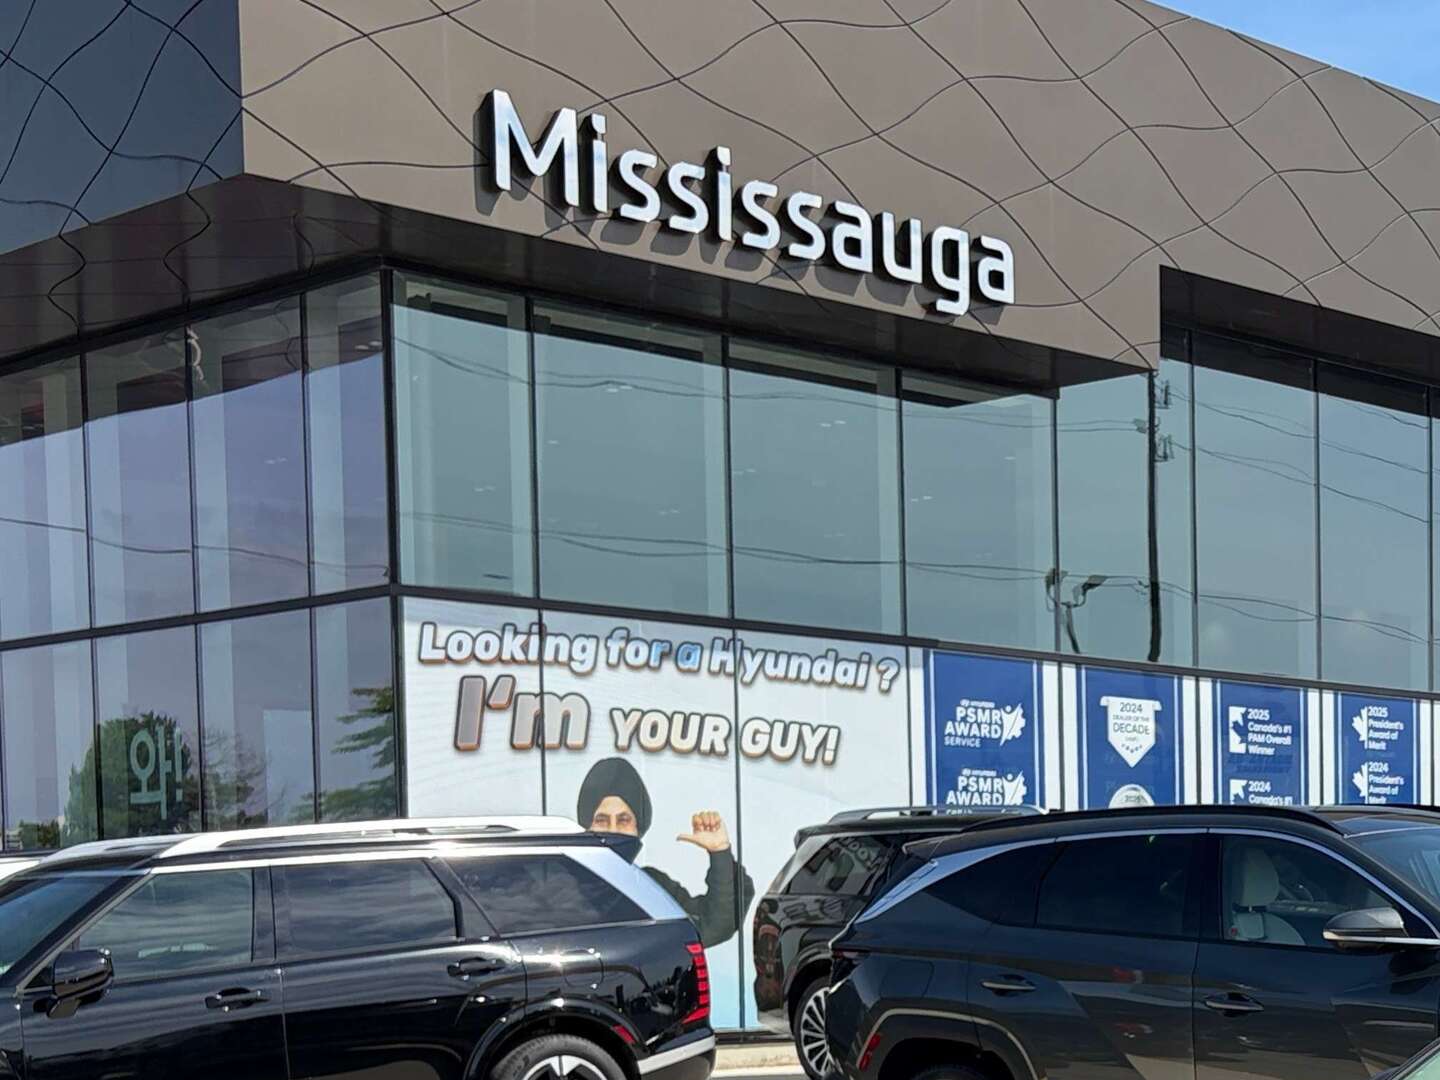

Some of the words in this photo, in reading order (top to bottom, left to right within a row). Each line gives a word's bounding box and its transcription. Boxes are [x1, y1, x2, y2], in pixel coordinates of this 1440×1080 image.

[490, 88, 1015, 317] Mississauga
[418, 620, 598, 675] Looking
[605, 626, 677, 671] for
[676, 640, 703, 670] a
[708, 636, 869, 689] Hyundai
[1119, 701, 1143, 713] 2024
[1367, 706, 1388, 717] 2025
[454, 674, 591, 751] I'm
[610, 706, 732, 757] YOUR
[740, 717, 842, 765] GUY!
[955, 706, 1002, 725] PSMR
[1247, 708, 1270, 720] 2025
[944, 720, 1002, 739] AWARD
[1112, 722, 1150, 735] DECADE
[1247, 721, 1282, 733] Canada's
[1283, 725, 1293, 734] #1
[944, 736, 981, 748] SERVICE
[1247, 732, 1265, 743] PAM
[957, 775, 1003, 793] PSMR
[1248, 781, 1271, 792] 2024
[945, 790, 1003, 806] AWARD
[1248, 794, 1283, 806] Canada's
